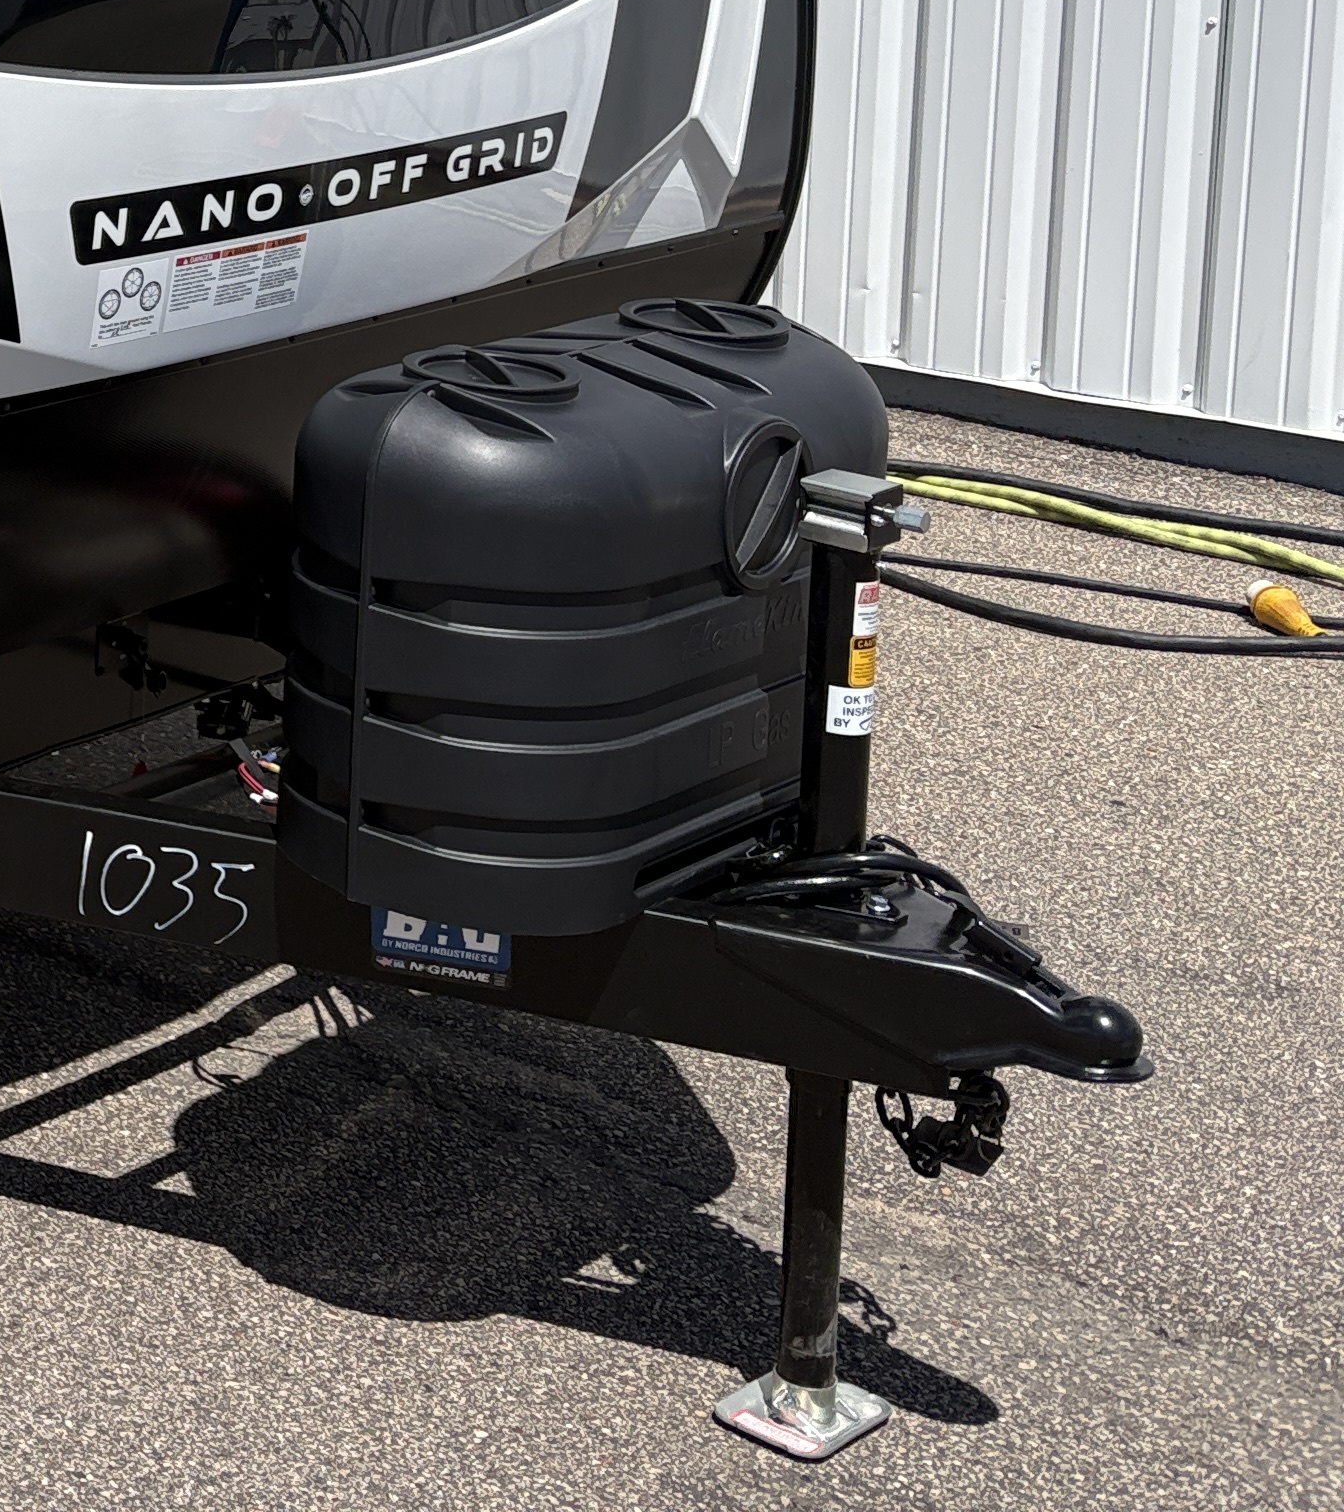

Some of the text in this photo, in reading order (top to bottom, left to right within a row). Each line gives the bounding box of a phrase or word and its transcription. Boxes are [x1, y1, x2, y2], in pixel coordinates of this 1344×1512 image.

[92, 126, 555, 250] NANO OFF GRID
[843, 695, 861, 705] OK
[842, 705, 875, 717] INSPE
[833, 717, 851, 728] BY
[78, 830, 256, 945] 1035
[381, 937, 394, 948] BY
[395, 939, 429, 954] NORCO
[440, 966, 492, 984] FRAME
